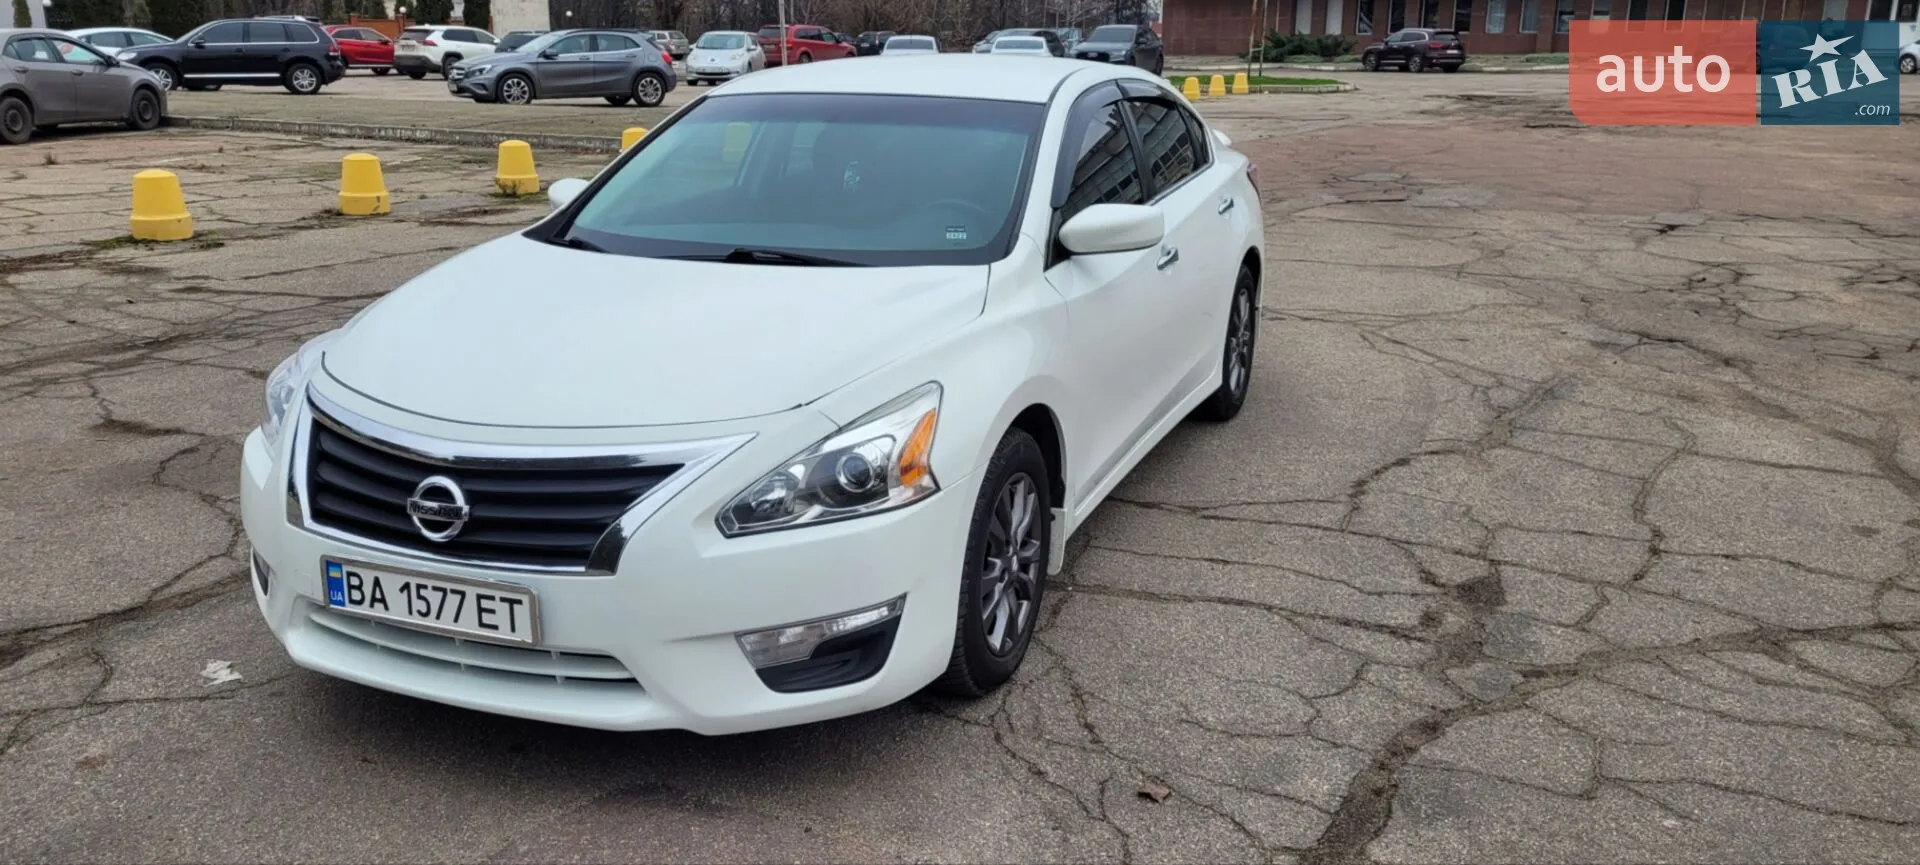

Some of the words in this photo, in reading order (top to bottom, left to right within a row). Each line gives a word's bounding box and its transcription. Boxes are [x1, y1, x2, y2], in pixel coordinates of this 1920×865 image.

[408, 502, 463, 520] NISSAN
[330, 591, 344, 602] UA
[346, 571, 390, 612] BA
[399, 580, 466, 624] 1577
[475, 593, 523, 633] ET
